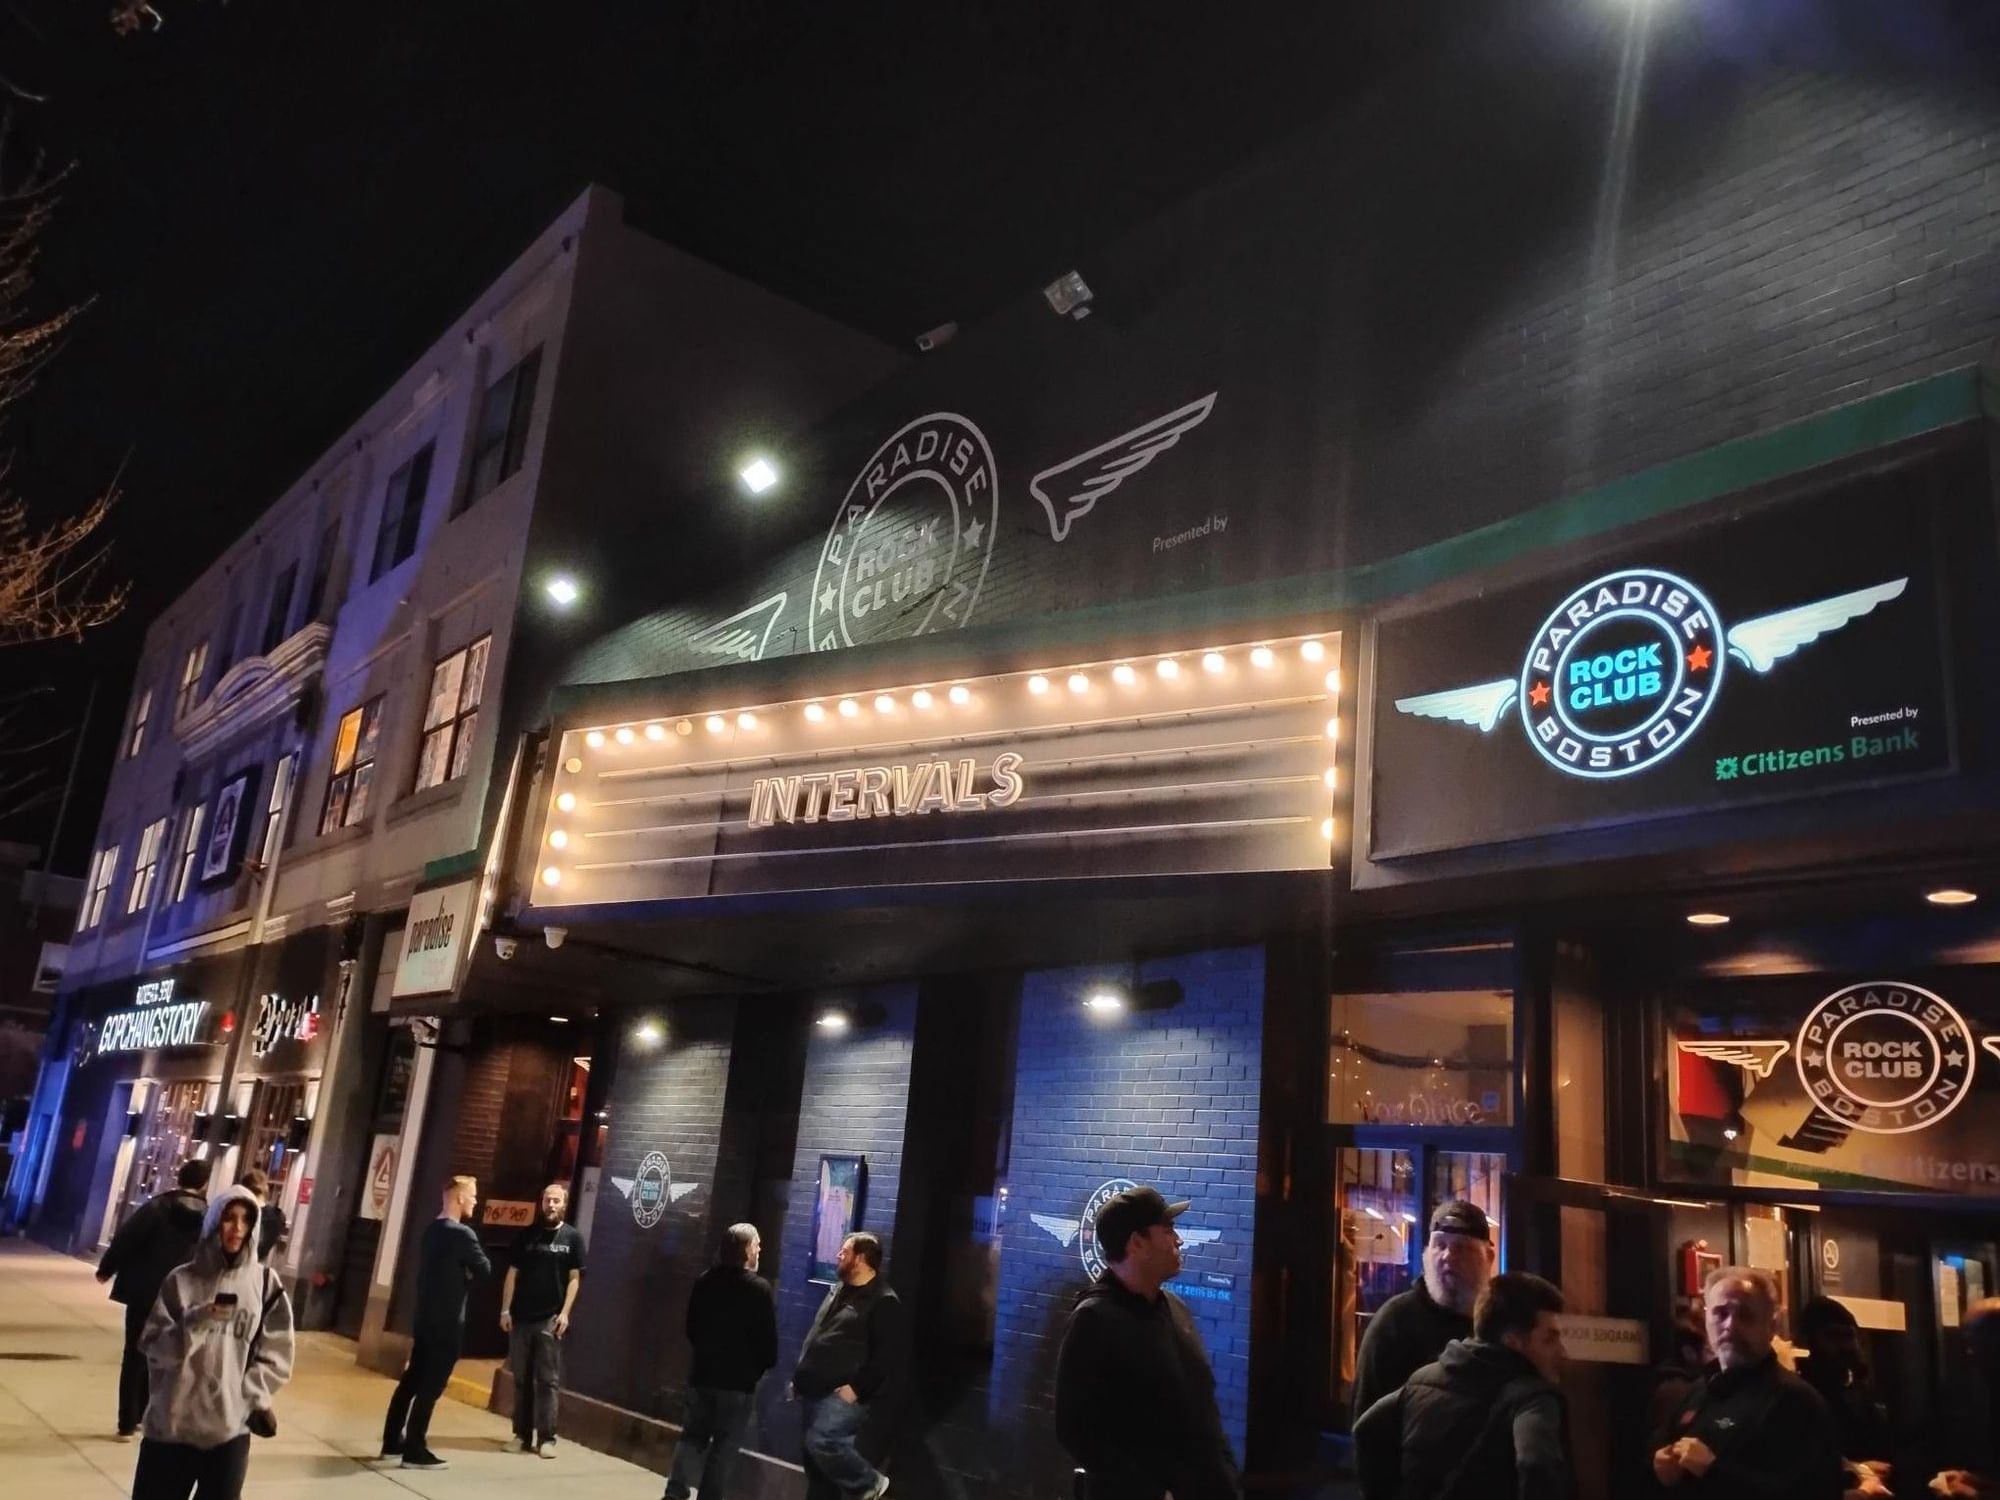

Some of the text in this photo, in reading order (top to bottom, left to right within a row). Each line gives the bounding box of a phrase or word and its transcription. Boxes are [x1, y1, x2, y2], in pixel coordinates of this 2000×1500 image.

[826, 430, 987, 566] PARADISE
[855, 516, 941, 582] ROCK
[1152, 515, 1228, 554] Presented by
[852, 558, 936, 619] CLUB
[1532, 580, 1710, 672] PARADISE
[1569, 642, 1663, 686] ROCK
[1569, 671, 1662, 711] CLUB
[1535, 687, 1703, 768] BOSTON
[1850, 706, 1919, 729] Presented by
[1742, 728, 1920, 777] Citizens Bank
[748, 752, 1026, 828] INTERVALS
[407, 896, 455, 961] paradise
[1808, 989, 1964, 1045] PARADISE
[1843, 1042, 1922, 1060] ROCK
[1845, 1060, 1923, 1079] CLUB
[1812, 1078, 1960, 1127] BOSTON
